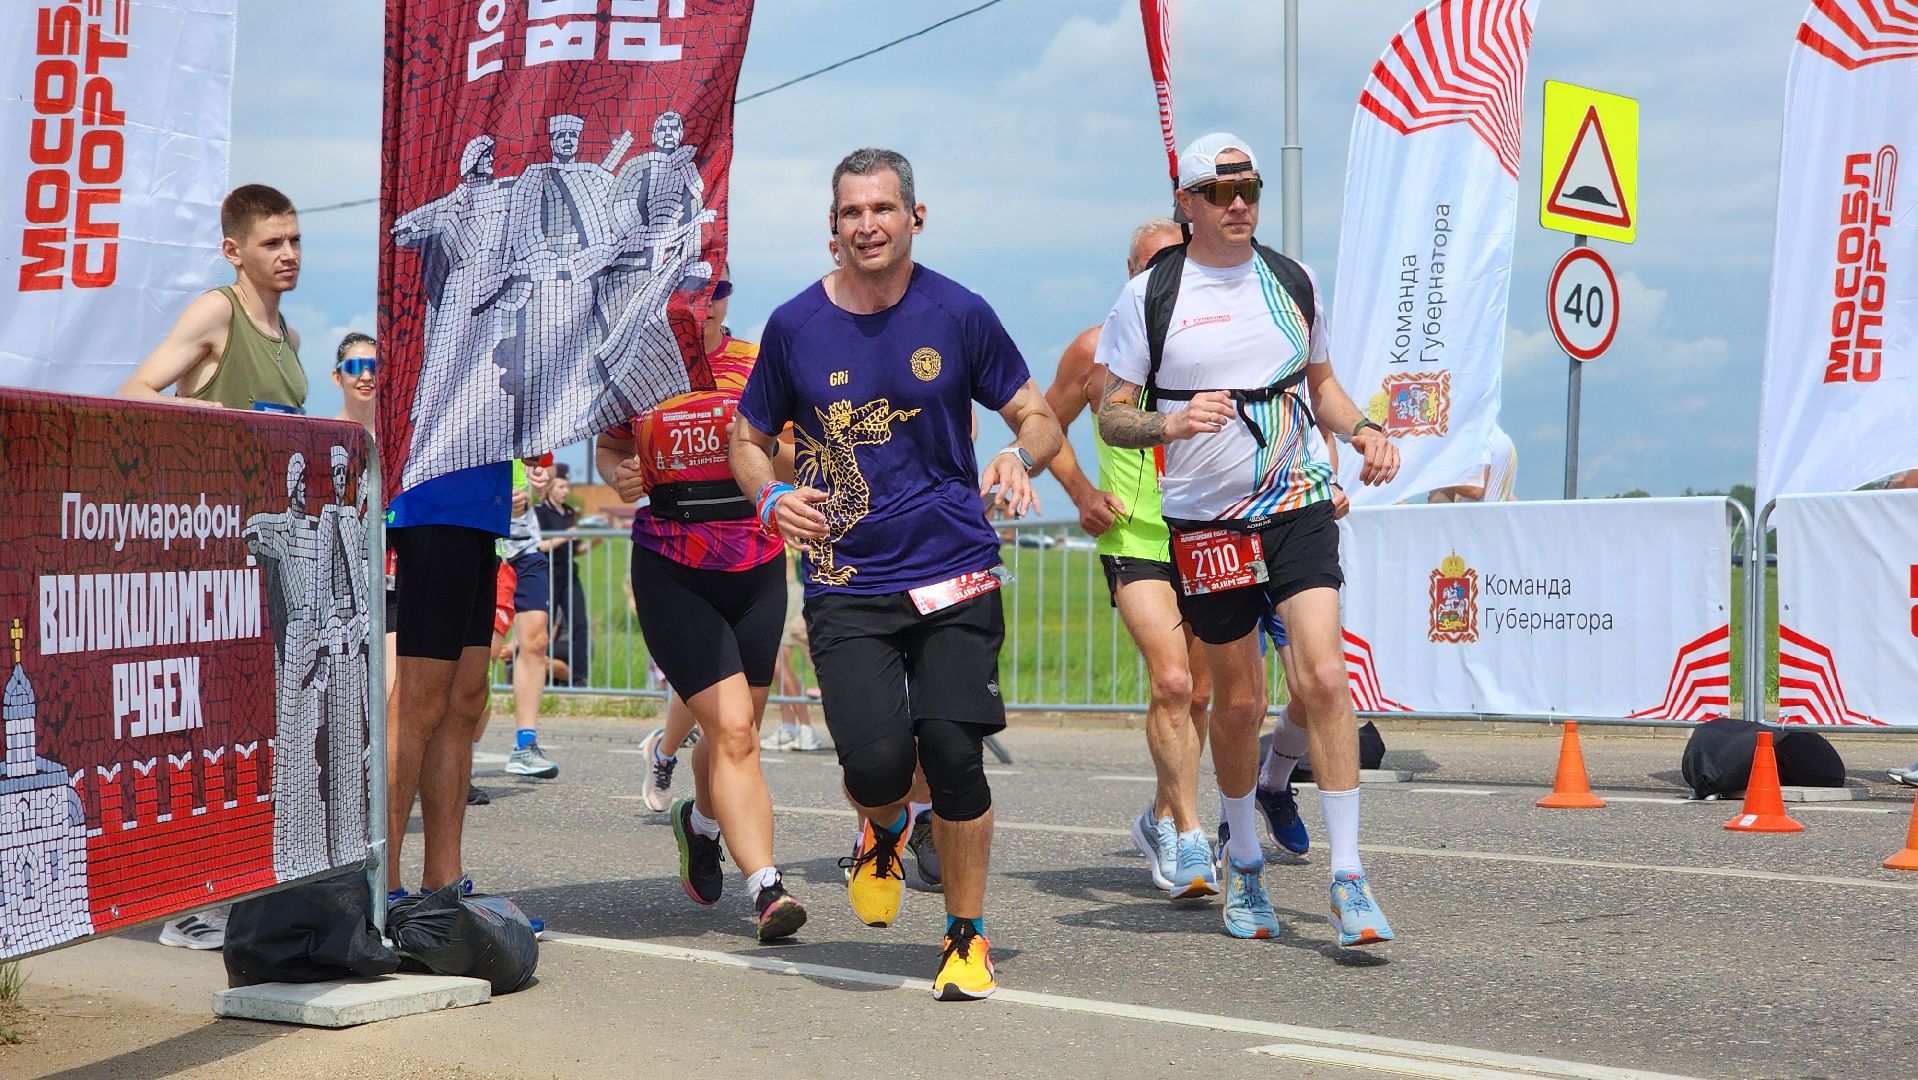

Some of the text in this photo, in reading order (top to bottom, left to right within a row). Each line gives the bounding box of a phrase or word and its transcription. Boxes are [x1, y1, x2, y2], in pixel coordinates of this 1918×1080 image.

[18, 0, 82, 291] МОСОБ
[71, 23, 128, 288] СПОРТ
[1389, 254, 1420, 364] Команда
[1419, 204, 1453, 363] Губернатора
[1563, 283, 1604, 328] 40
[1823, 153, 1871, 384] МОСОБЛ
[1852, 202, 1892, 382] СПОРТ
[829, 370, 849, 387] GRi
[670, 426, 720, 455] 2136
[62, 493, 240, 551] Полумарафон
[1191, 543, 1240, 578] 2110
[39, 555, 261, 656] ВОЛОКОЛАМСКИЙ
[1485, 574, 1571, 599] Команда
[1485, 608, 1613, 635] Губернатора
[112, 656, 204, 740] РУБЕЖ
